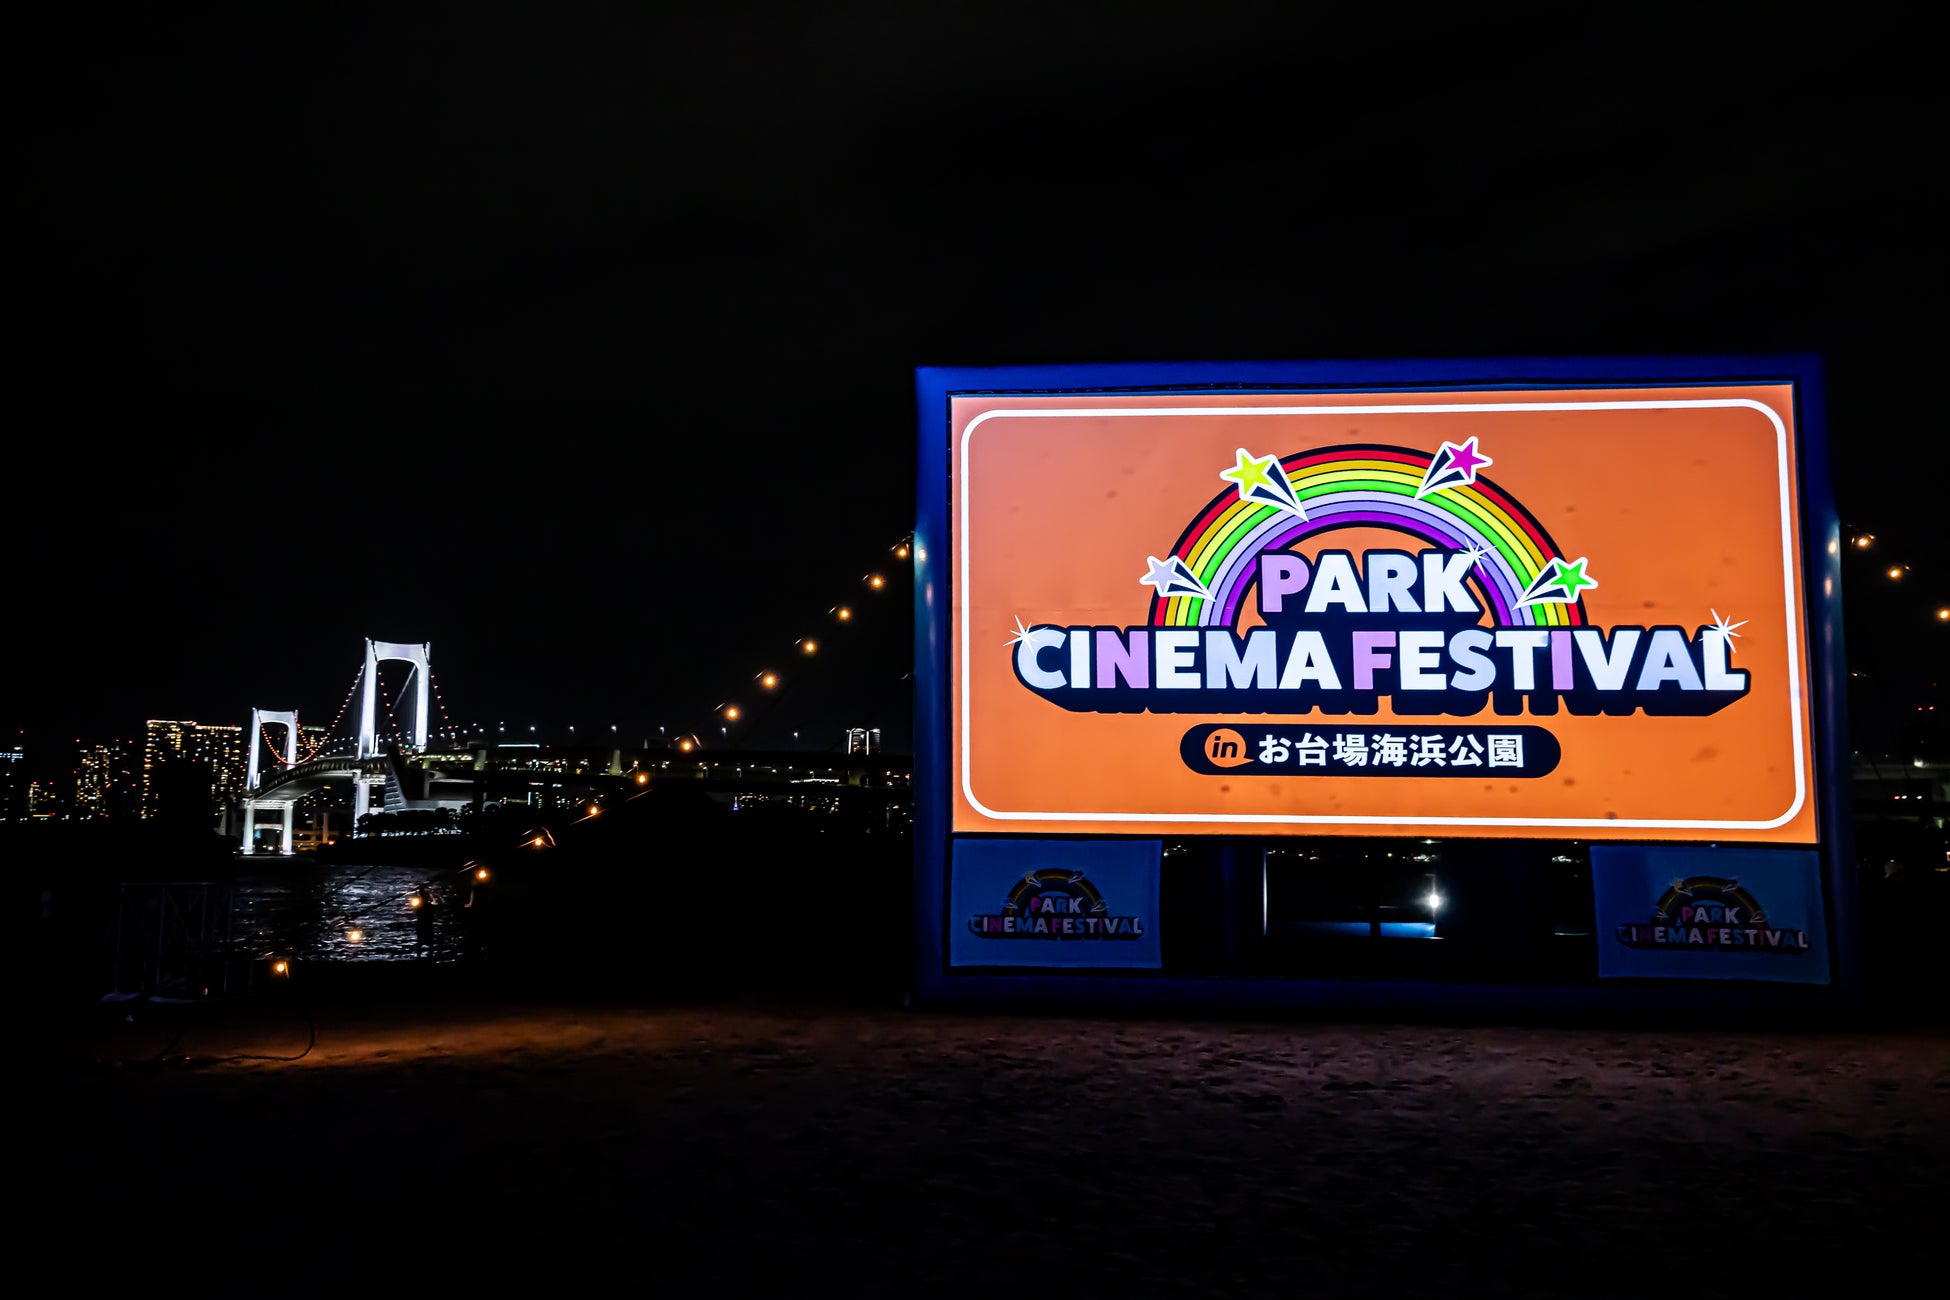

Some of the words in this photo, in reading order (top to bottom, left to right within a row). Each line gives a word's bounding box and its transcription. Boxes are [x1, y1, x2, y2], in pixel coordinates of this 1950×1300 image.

[1261, 552, 1481, 613] PARK
[1017, 629, 1343, 690] CINEMA
[1352, 629, 1746, 692] FESTIVAL
[1212, 735, 1239, 759] in
[1258, 732, 1525, 768] お台場海浜公園
[1029, 896, 1083, 914] PARK
[1681, 905, 1742, 924] PARK
[970, 915, 1049, 934] CINEMA
[1050, 916, 1144, 935] FESTIVAL
[1616, 925, 1704, 945] CINEMA
[1705, 927, 1809, 949] FESTIVAL
